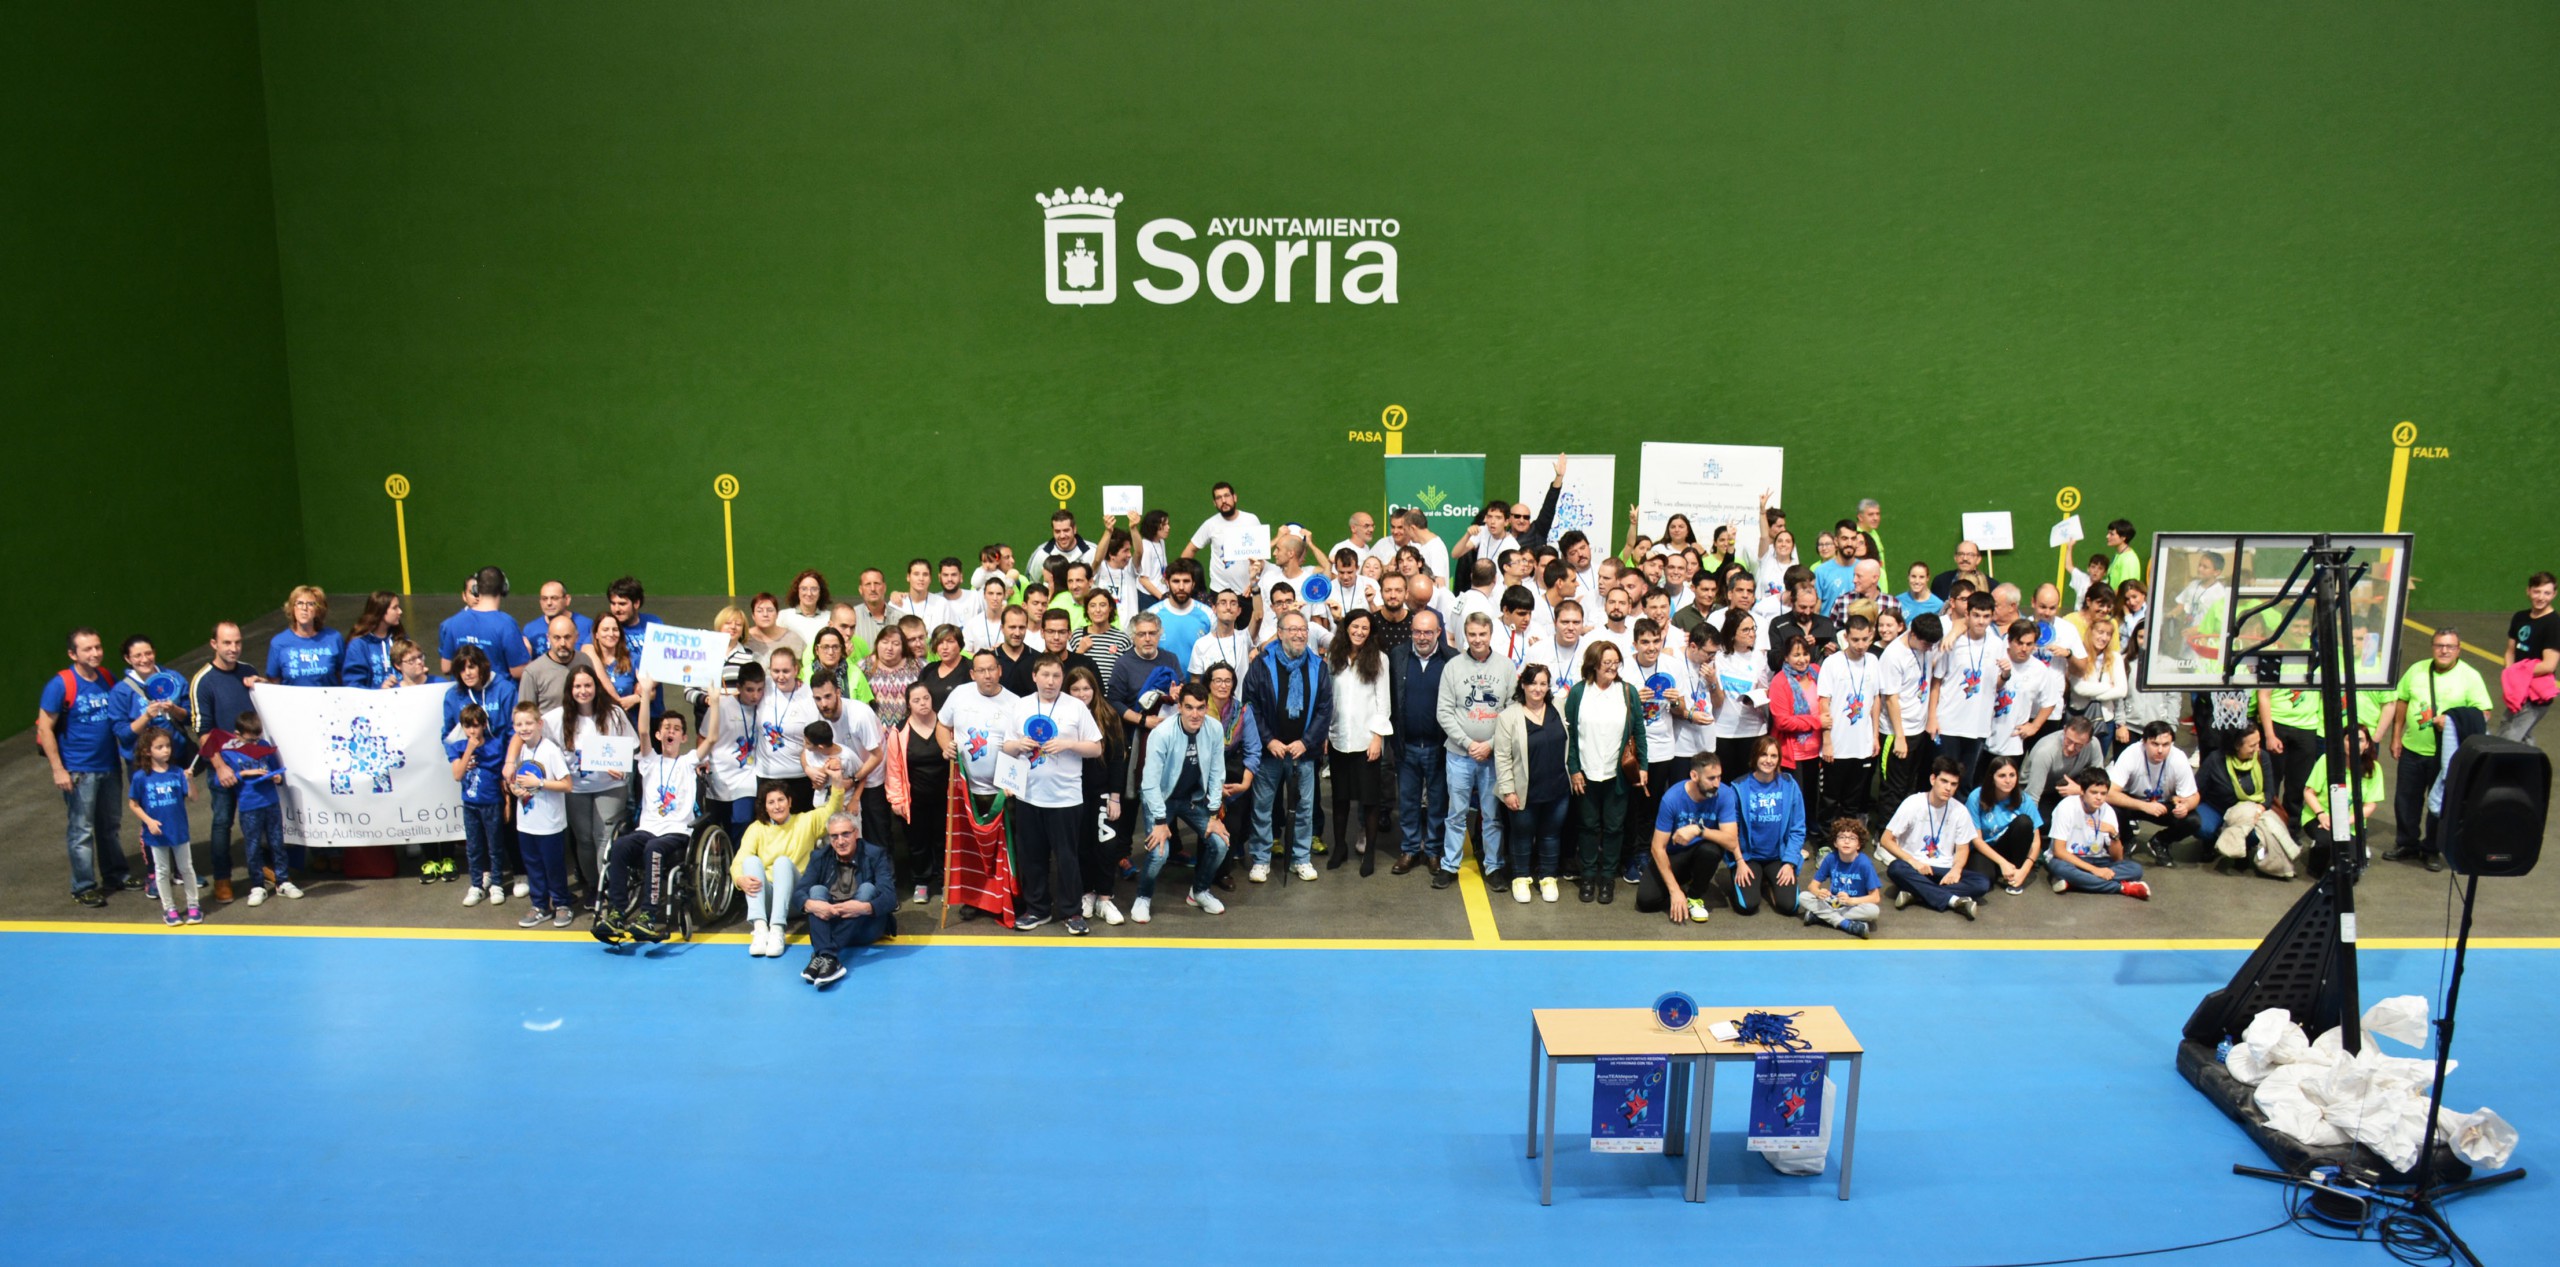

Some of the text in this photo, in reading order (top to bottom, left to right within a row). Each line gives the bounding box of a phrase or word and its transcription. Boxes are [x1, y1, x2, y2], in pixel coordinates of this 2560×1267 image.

[1207, 217, 1400, 237] AYUNTAMIENTO
[1132, 217, 1399, 305] Soria
[1389, 410, 1400, 427] 7
[1348, 430, 1383, 443] PASA
[2397, 426, 2410, 442] 4
[2412, 447, 2449, 458] FALTA
[389, 478, 405, 495] 10
[721, 479, 733, 495] 9
[1057, 479, 1069, 495] 8
[2062, 491, 2074, 507] 5
[1442, 503, 1480, 517] Soria
[286, 803, 464, 826] utismo León
[282, 823, 465, 840] deración Autismo Castilla y Le
